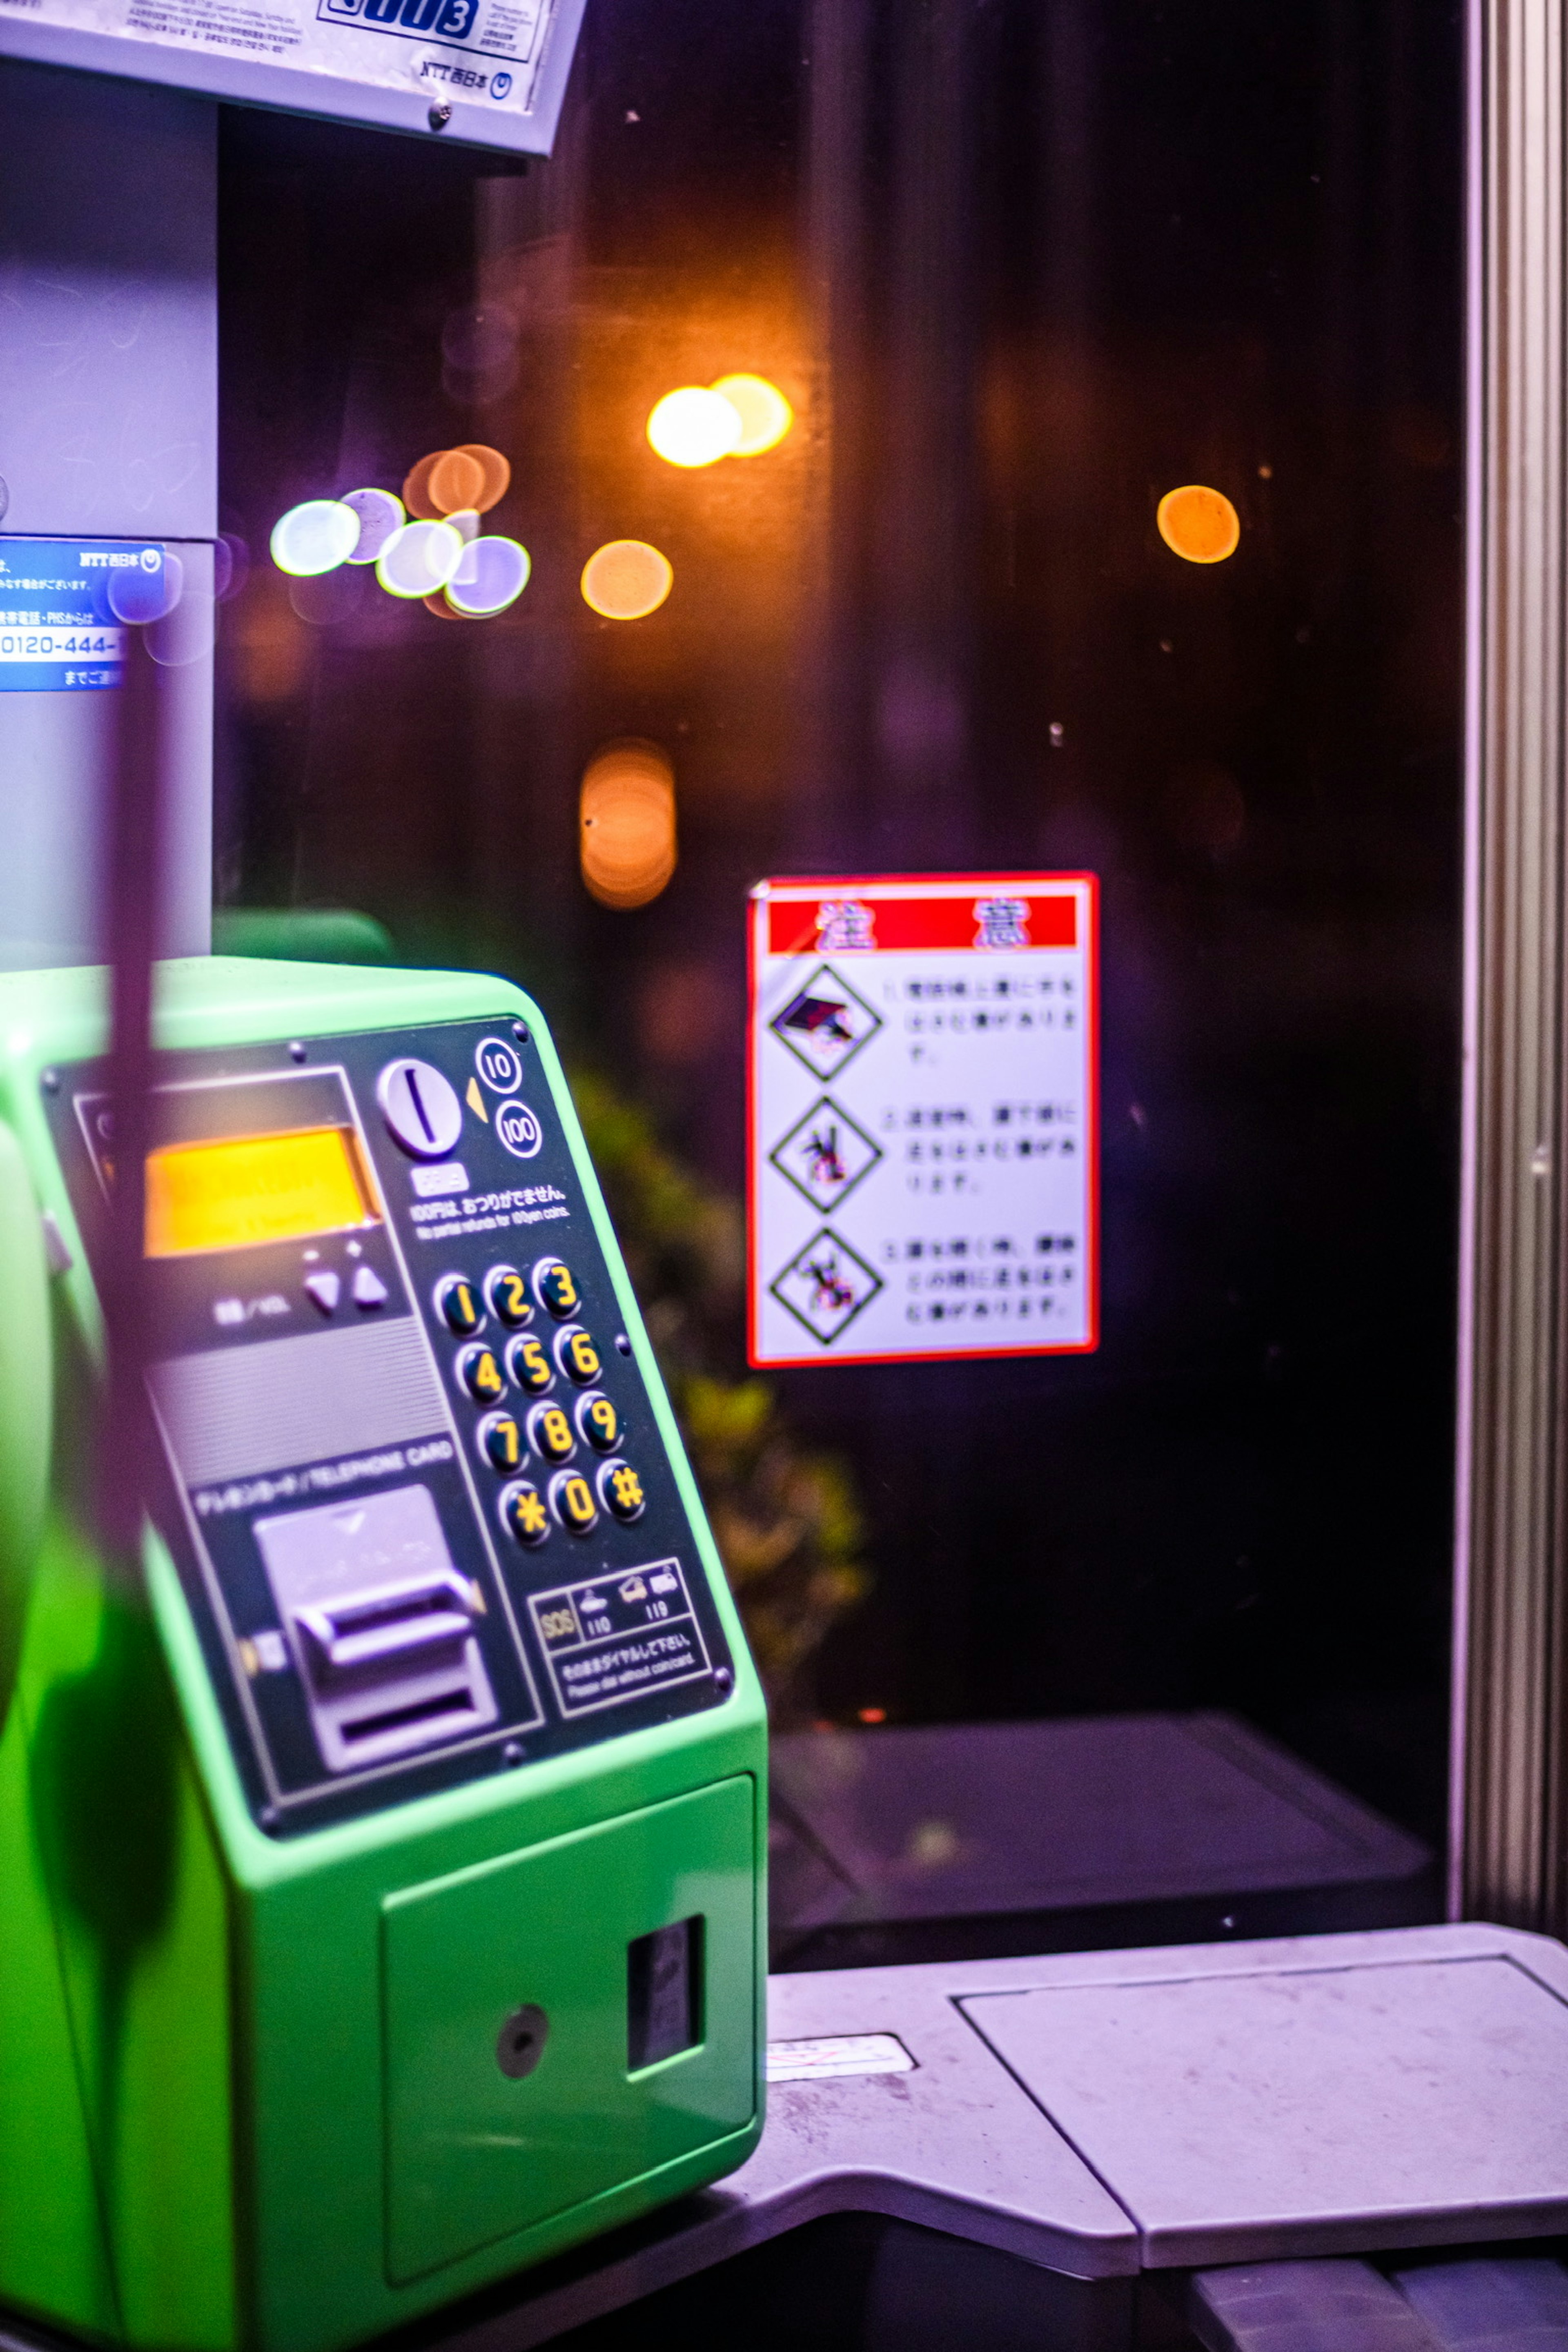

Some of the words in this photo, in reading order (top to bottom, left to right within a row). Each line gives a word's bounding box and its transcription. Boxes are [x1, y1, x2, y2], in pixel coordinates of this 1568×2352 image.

[421, 61, 489, 89] NTT西日本
[485, 1054, 511, 1078] 10
[503, 1117, 536, 1143] 100
[457, 1285, 475, 1323] 1
[503, 1275, 529, 1315] 2
[551, 1266, 576, 1305] 3
[477, 1353, 501, 1391] 4
[523, 1342, 550, 1384] 5
[571, 1333, 599, 1373] 6
[496, 1421, 519, 1463] 7
[543, 1410, 573, 1452] 8
[592, 1401, 616, 1440] 9
[405, 1441, 453, 1466] CARD
[566, 1477, 595, 1521] 0
[540, 1609, 574, 1639] SOS
[646, 1600, 668, 1620] 119
[587, 1616, 611, 1635] 110
